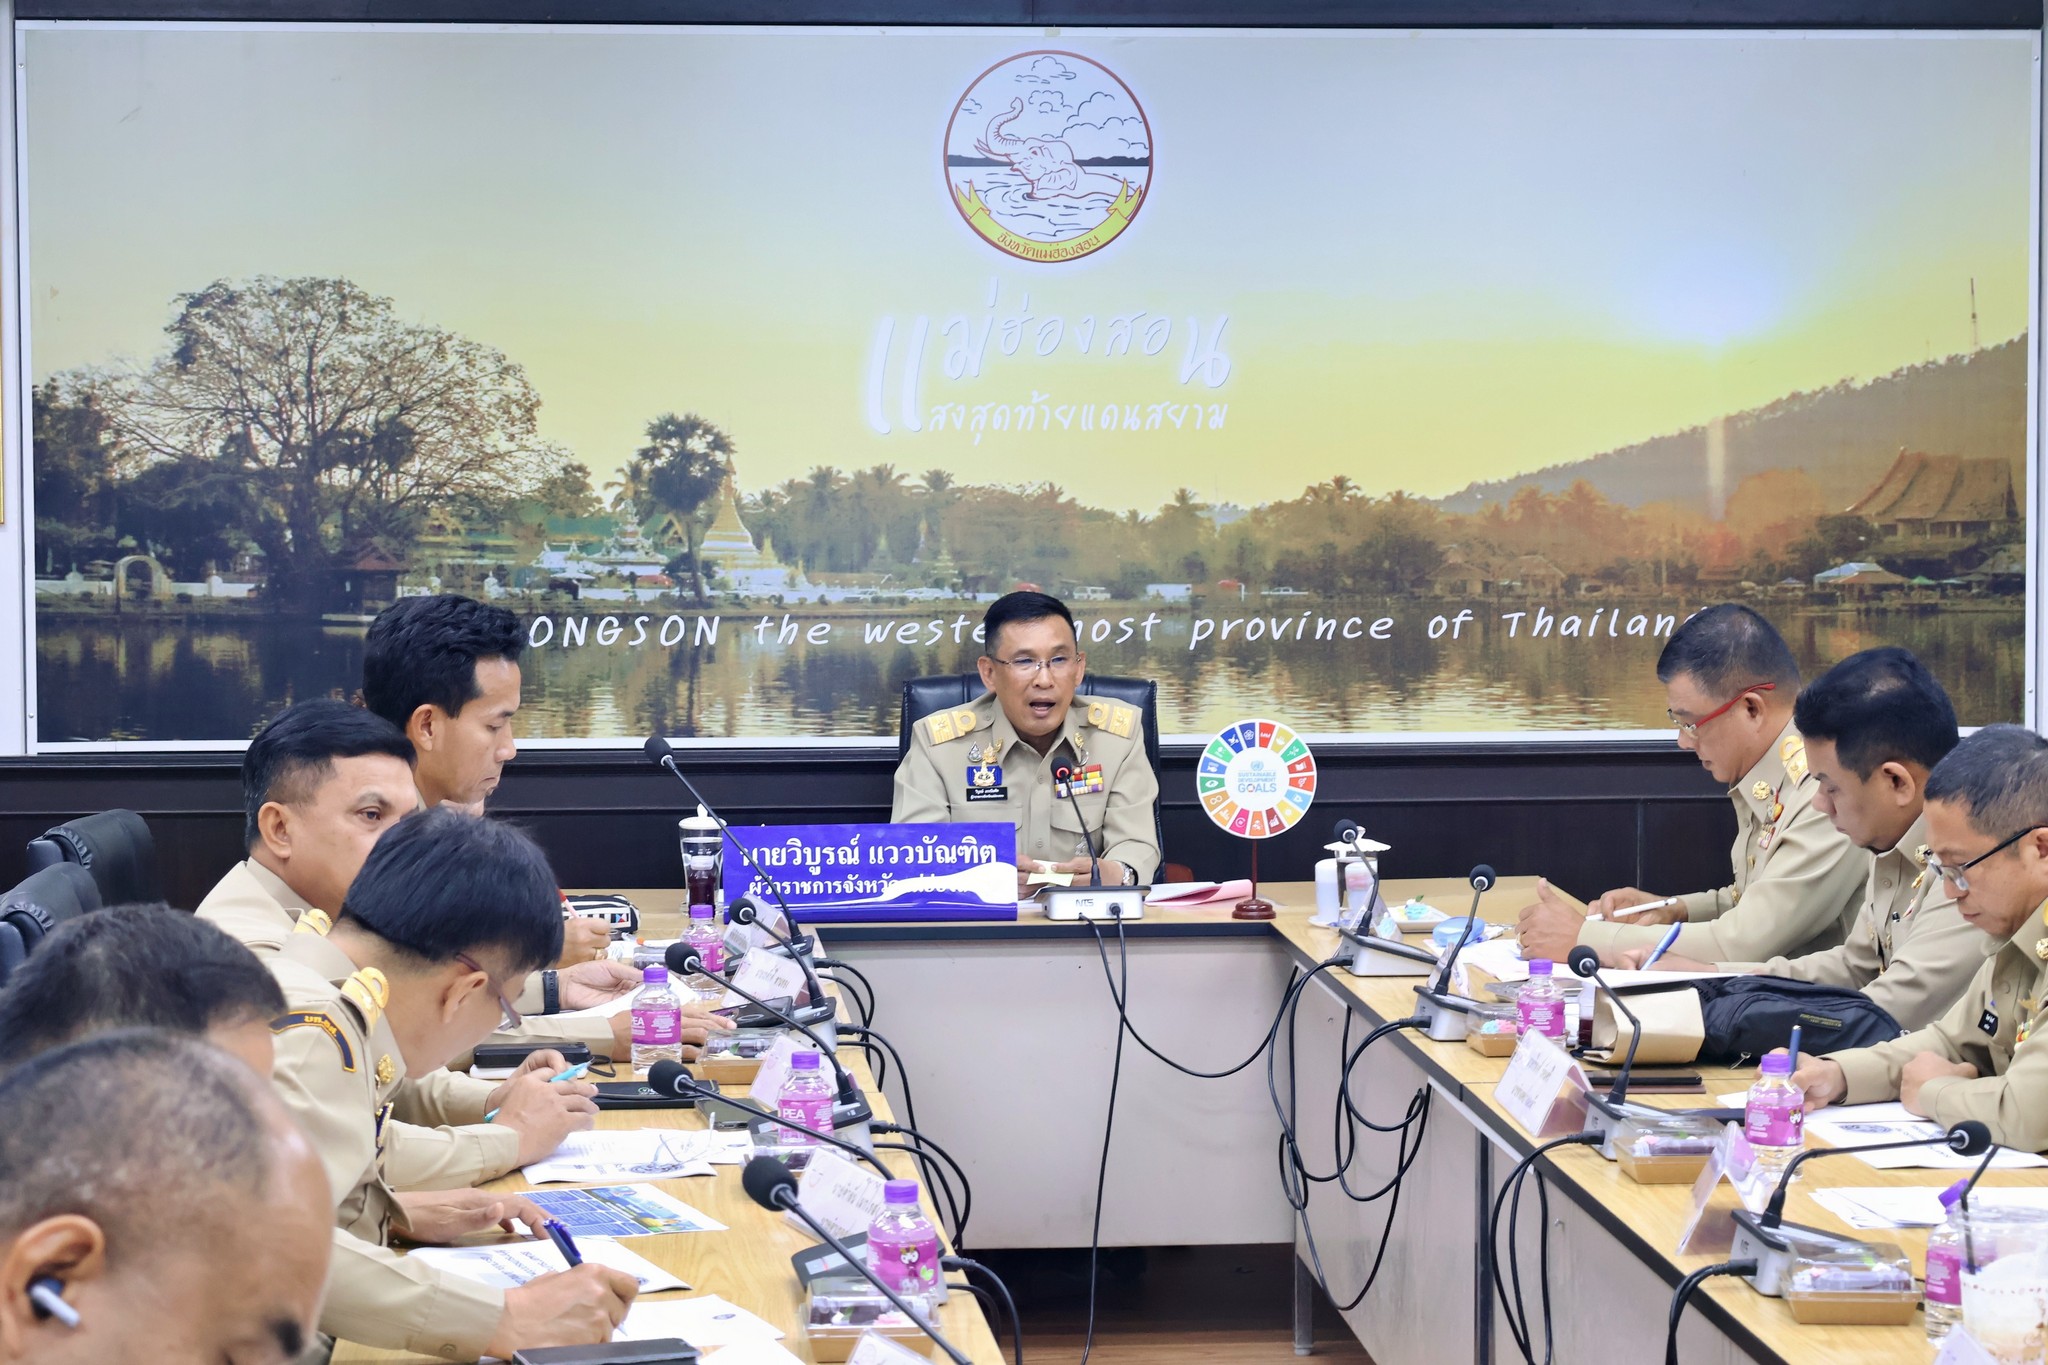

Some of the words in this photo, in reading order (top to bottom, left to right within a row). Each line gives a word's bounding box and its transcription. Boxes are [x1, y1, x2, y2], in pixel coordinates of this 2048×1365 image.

[528, 615, 720, 648] ONGSON
[753, 613, 832, 646] the
[1189, 611, 1394, 650] province
[1428, 609, 1474, 640] of
[1502, 606, 1708, 640] Thailan
[1238, 783, 1277, 792] GOALS
[782, 1108, 806, 1119] PEA
